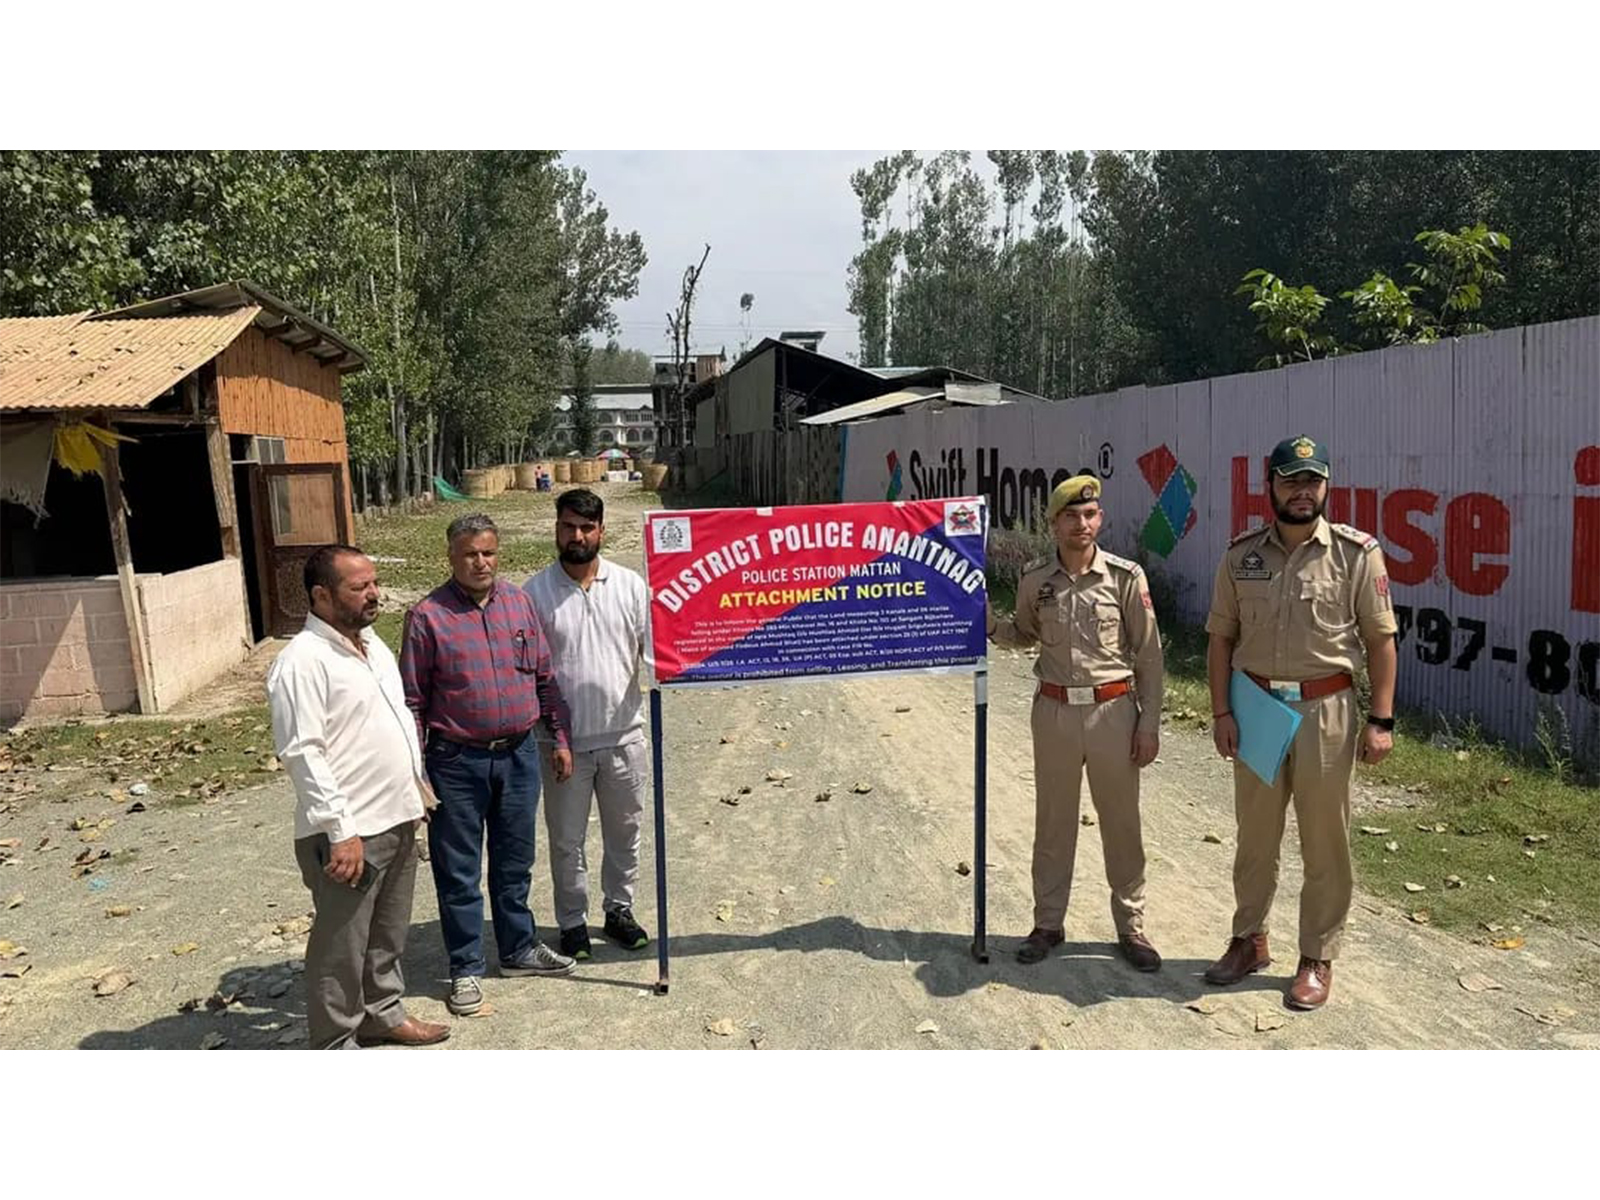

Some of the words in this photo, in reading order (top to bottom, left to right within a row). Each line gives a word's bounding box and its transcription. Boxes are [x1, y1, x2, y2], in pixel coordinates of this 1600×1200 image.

[976, 447, 1096, 533] Hom
[657, 535, 762, 613] DISTRICT
[769, 521, 854, 555] POLICE
[862, 524, 983, 595] ANANTNAG
[719, 585, 849, 608] ATTACHMENT
[856, 581, 926, 600] NOTICE
[742, 567, 789, 584] POLICE
[792, 564, 846, 582] STATION
[850, 562, 900, 577] MATTAN
